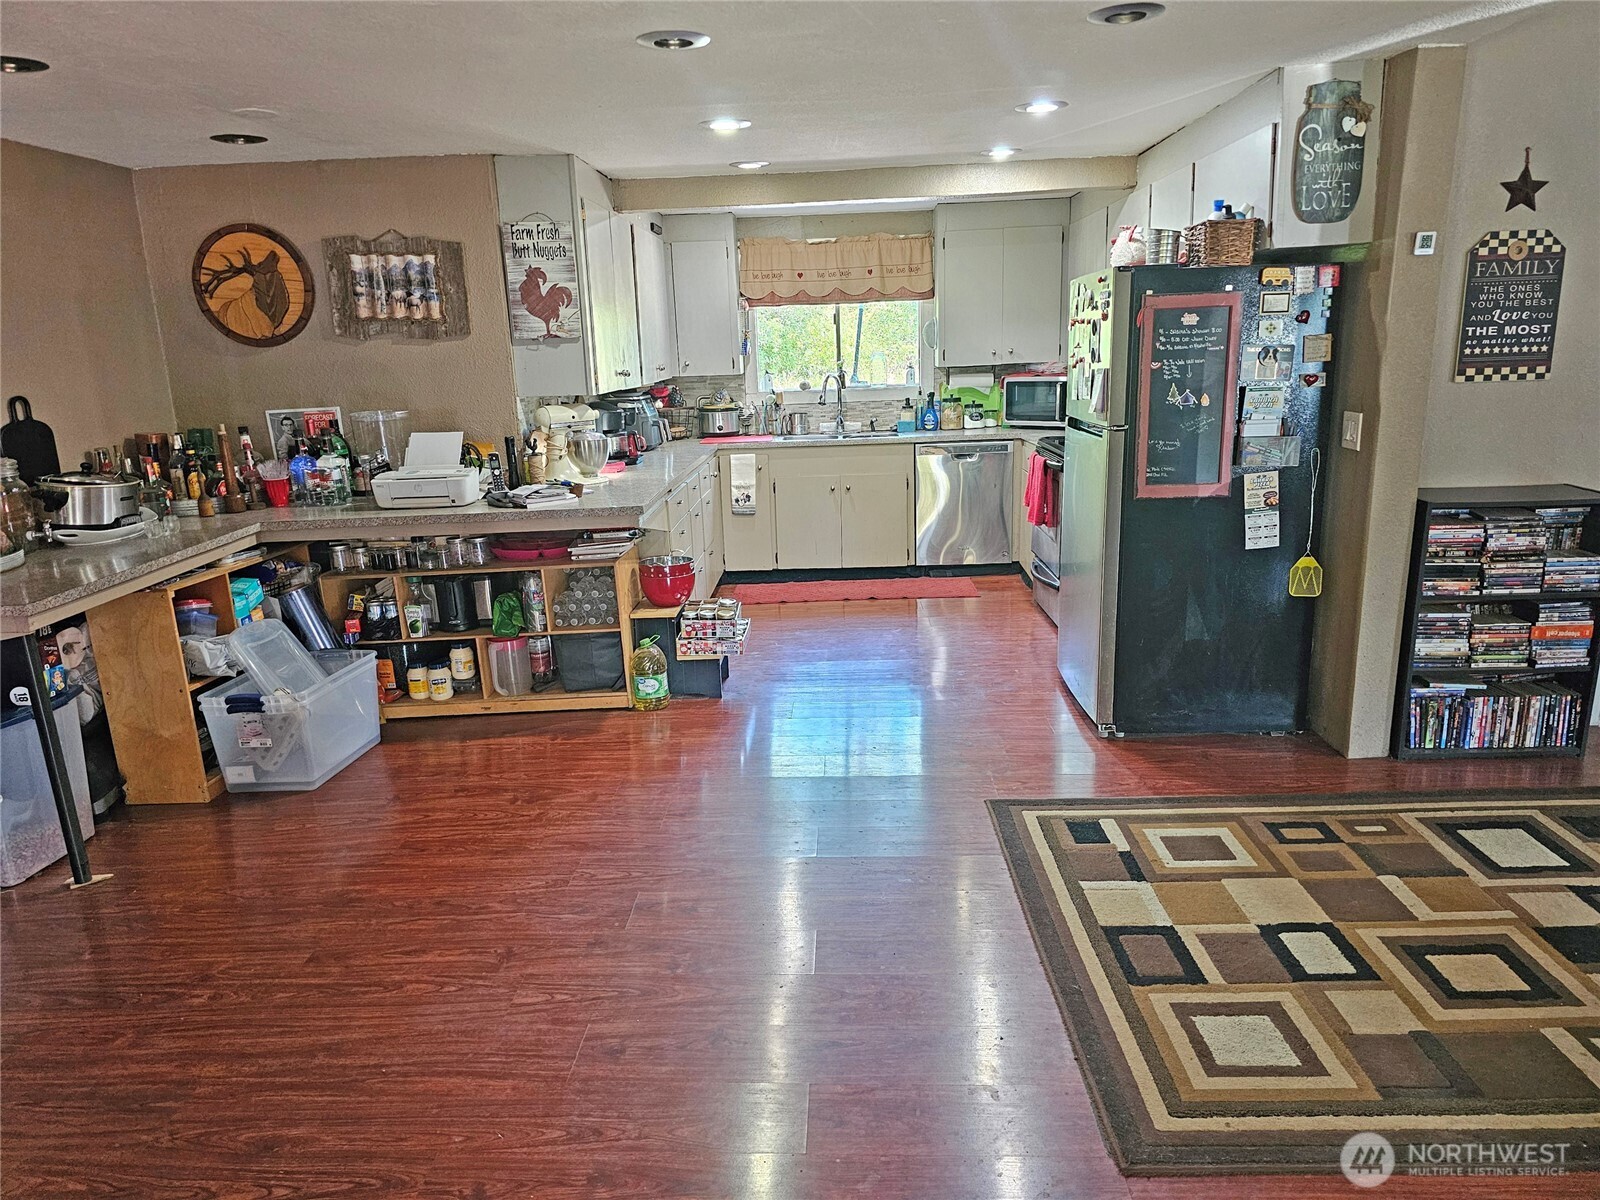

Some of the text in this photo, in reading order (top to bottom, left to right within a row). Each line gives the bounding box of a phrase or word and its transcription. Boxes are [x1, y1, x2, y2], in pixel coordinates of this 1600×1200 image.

[1299, 123, 1364, 162] Season
[1304, 161, 1361, 174] EVERYTHING
[1311, 168, 1344, 189] with
[1301, 182, 1351, 211] LOVE
[510, 223, 560, 241] Farm Fresh
[511, 242, 567, 260] Butt Nuggets
[1475, 259, 1560, 277] FAMILY
[1509, 284, 1541, 292] ONES
[1479, 291, 1543, 301] WHO KNOW
[1525, 298, 1554, 306] BEST
[1470, 314, 1492, 322] AND
[1492, 309, 1531, 324] Love
[1465, 324, 1552, 336] THE MOST
[1482, 337, 1517, 345] matter
[1545, 629, 1558, 637] cell
[17, 692, 29, 702] 18
